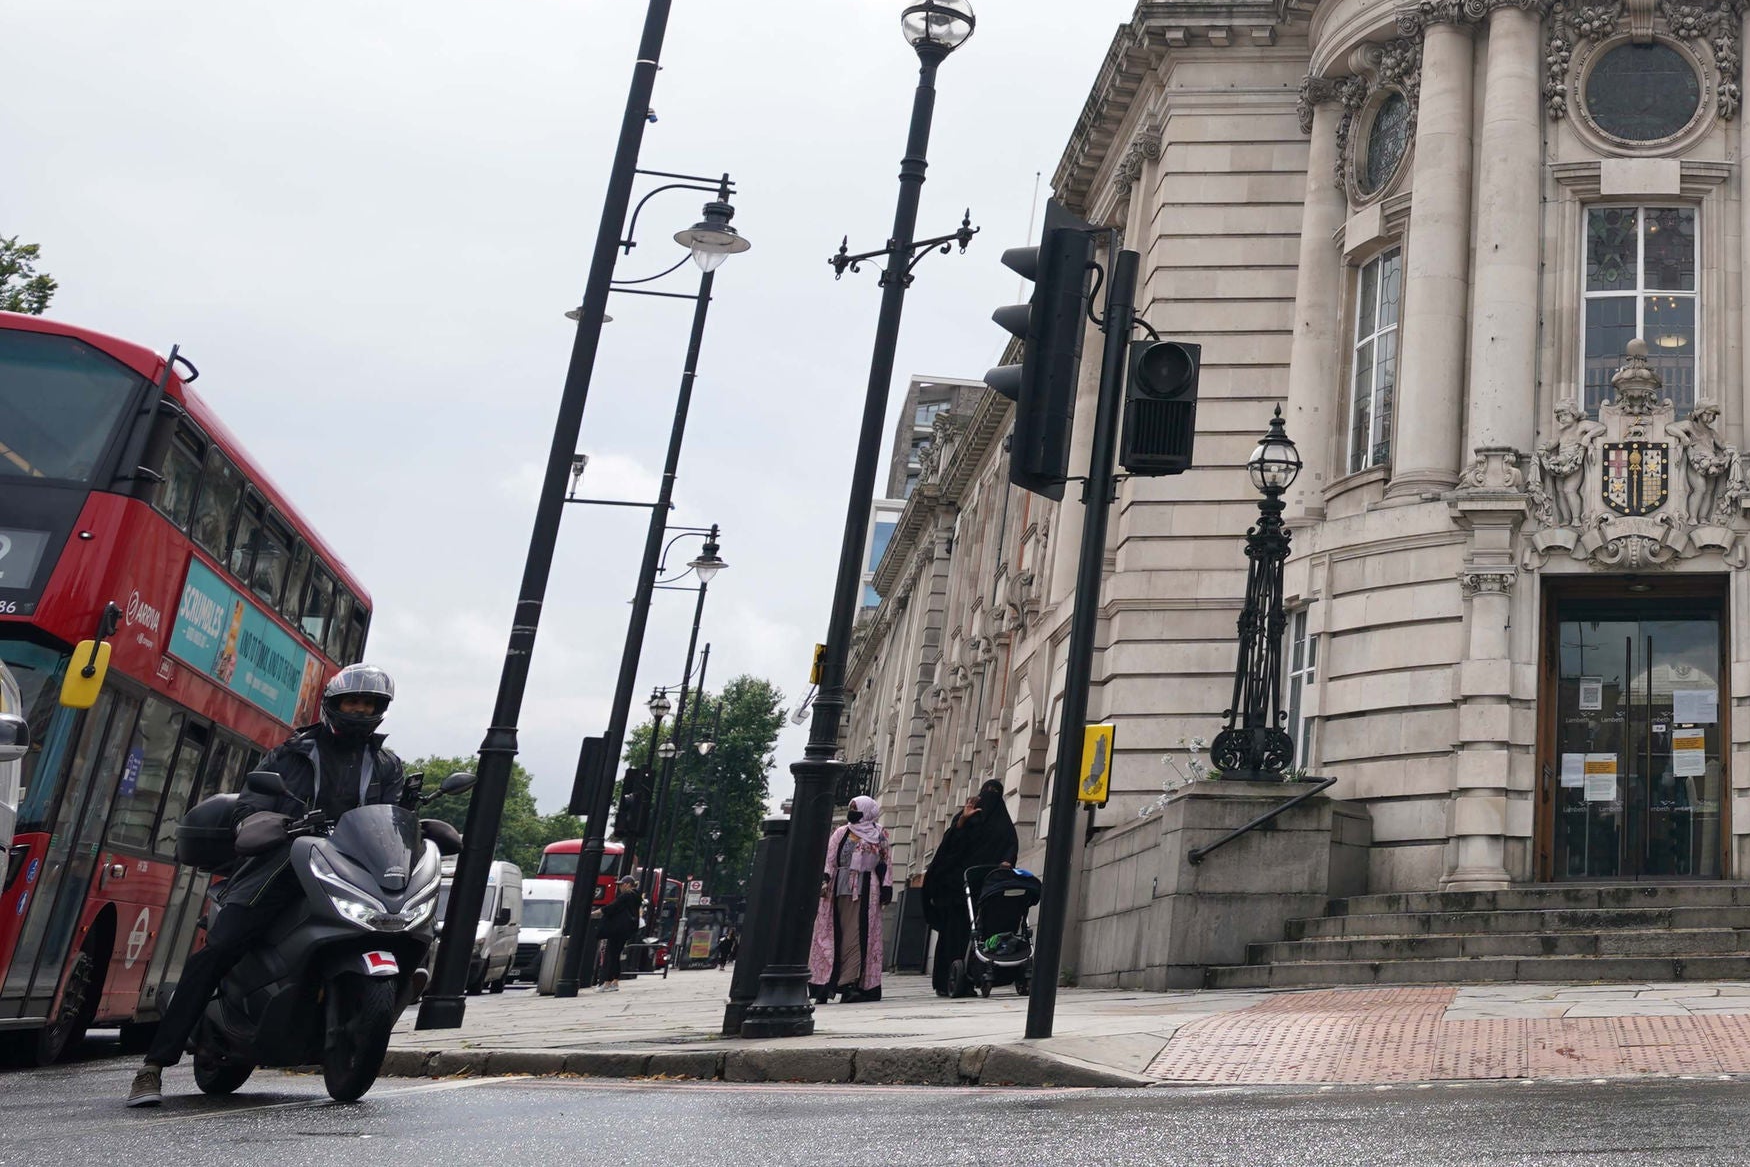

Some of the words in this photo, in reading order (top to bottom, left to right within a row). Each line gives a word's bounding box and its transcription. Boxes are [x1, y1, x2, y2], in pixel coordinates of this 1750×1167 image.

[135, 601, 160, 633] ARRIVA
[180, 584, 224, 639] SCRUMBLES
[368, 952, 396, 967] L
